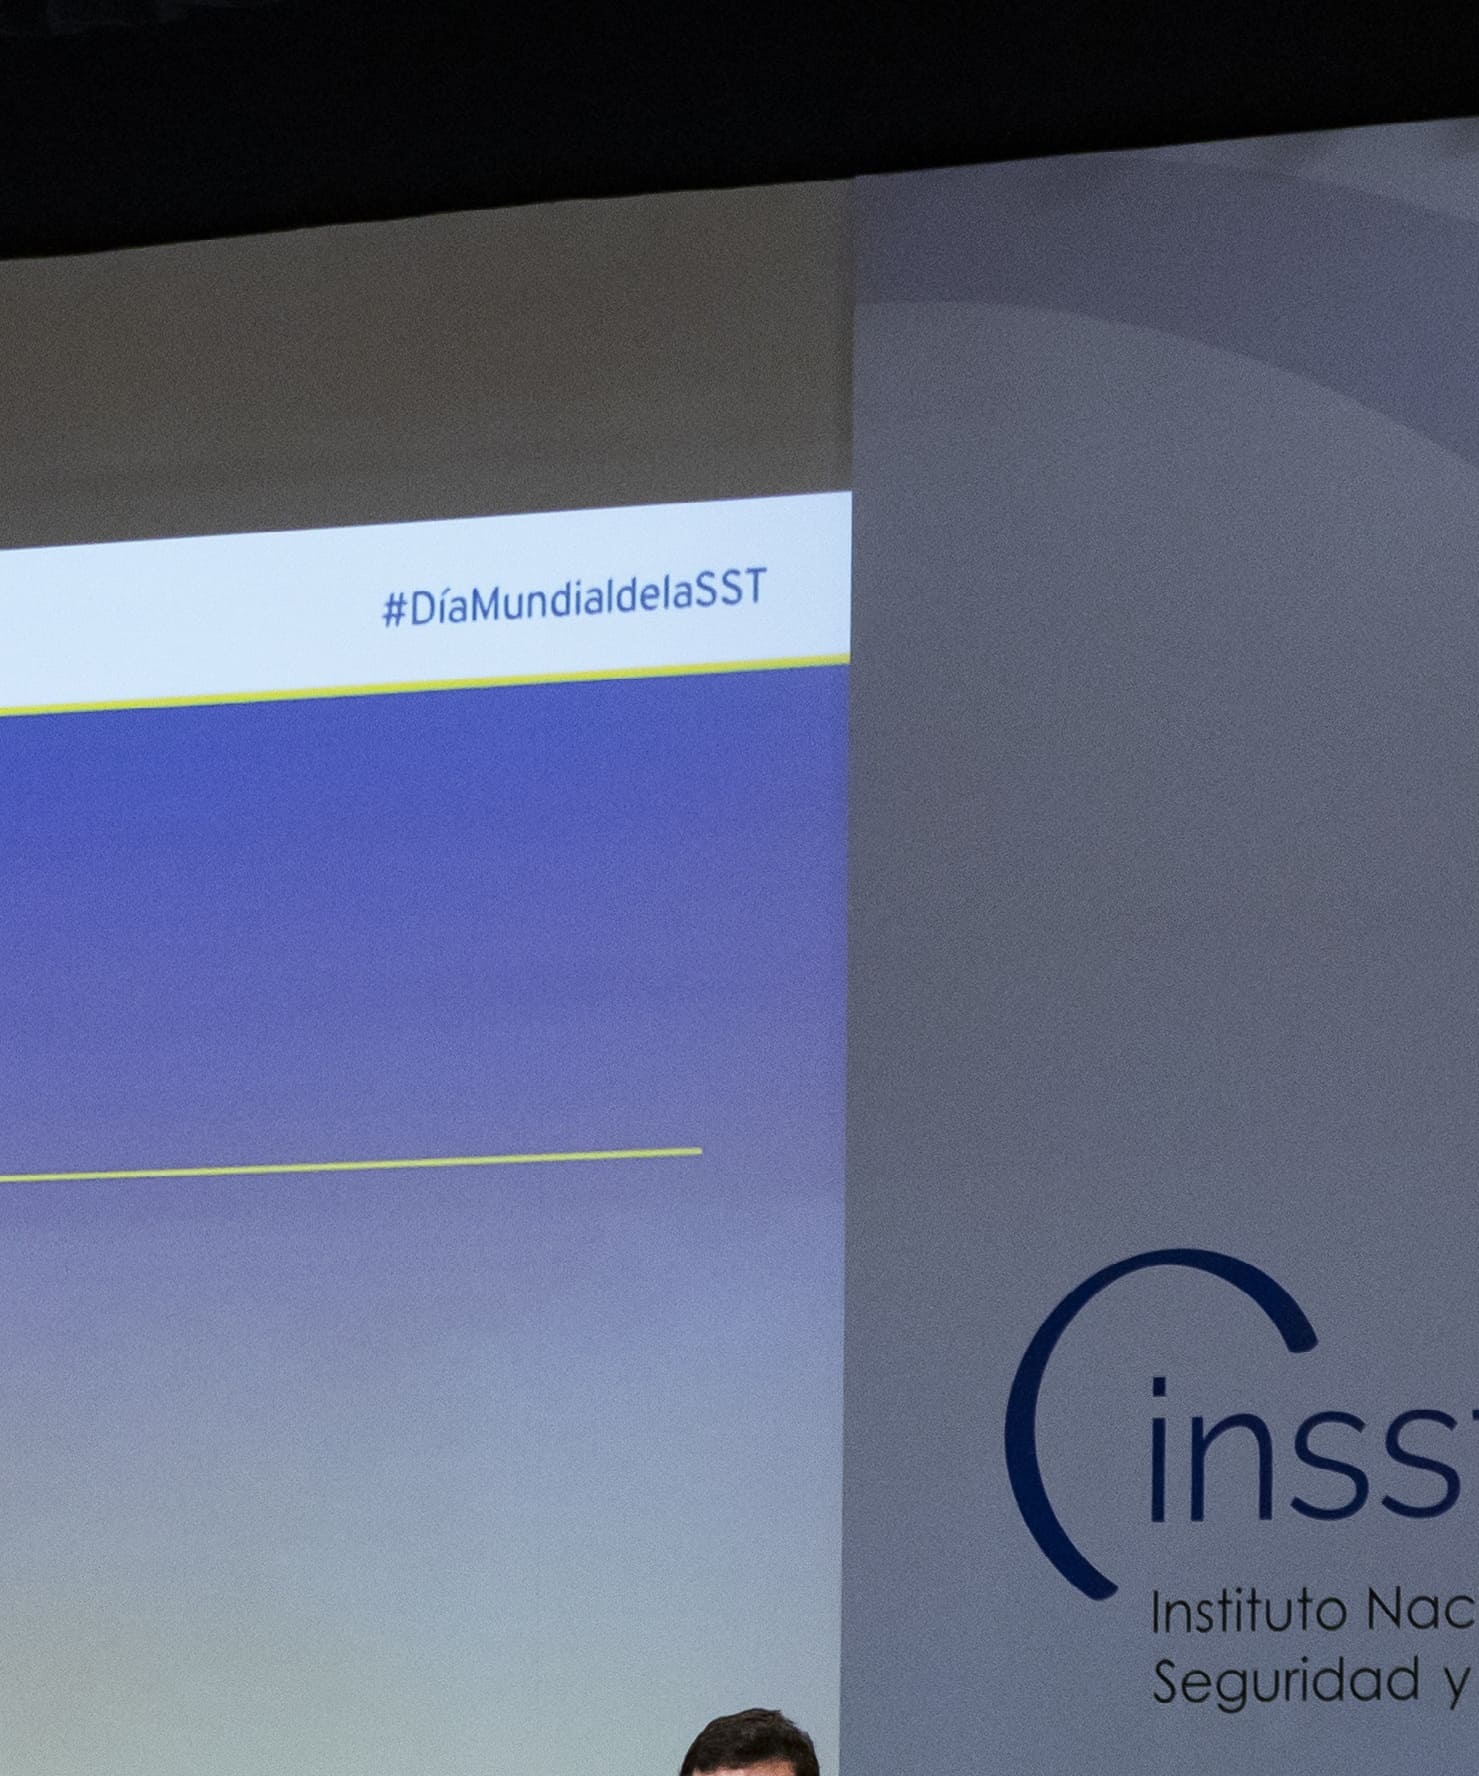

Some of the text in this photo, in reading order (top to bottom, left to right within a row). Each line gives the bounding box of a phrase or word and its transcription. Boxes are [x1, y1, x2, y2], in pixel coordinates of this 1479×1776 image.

[381, 566, 768, 628] #DíaMundialdelaSST
[1152, 1586, 1347, 1633] Instituto
[1152, 1655, 1419, 1713] Seguridad
[1443, 1666, 1472, 1711] y
